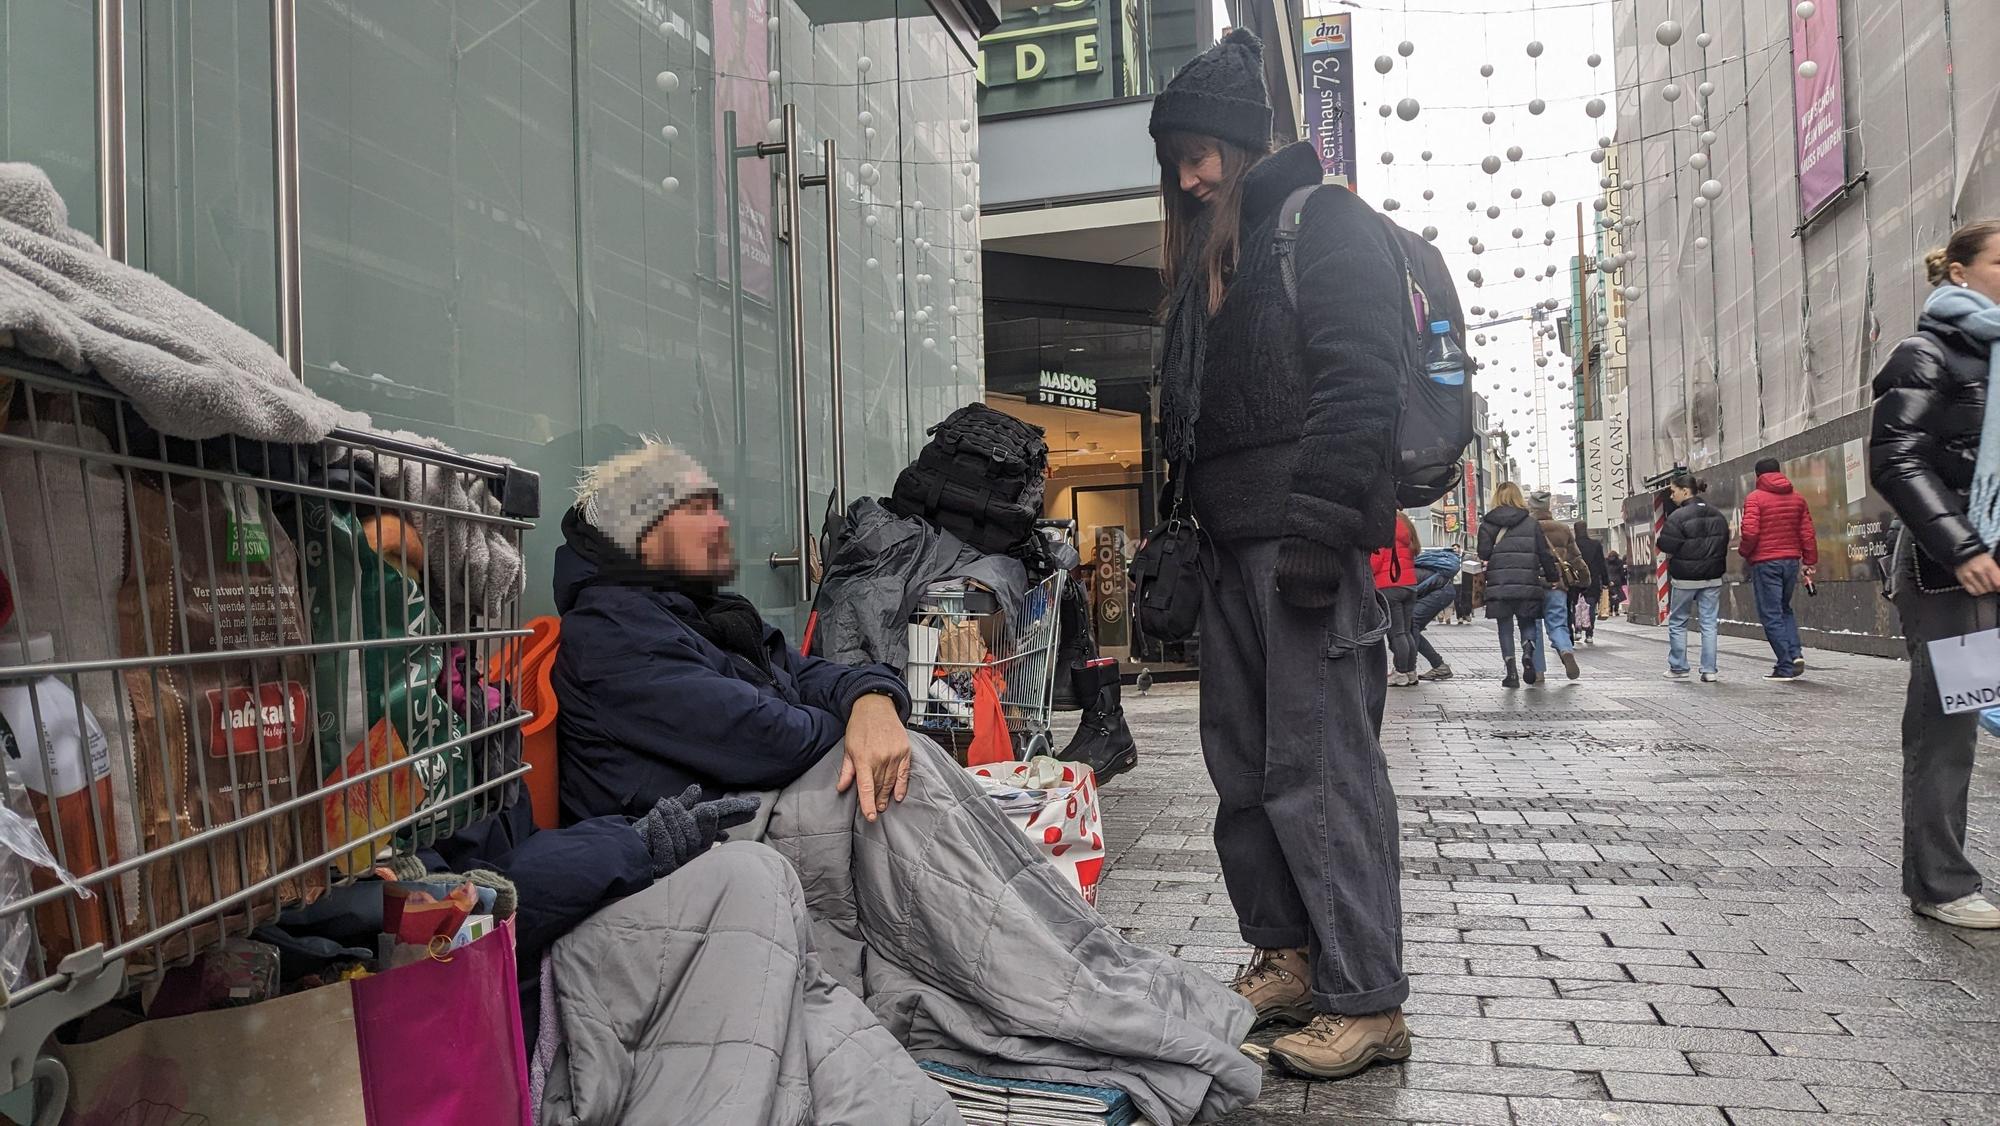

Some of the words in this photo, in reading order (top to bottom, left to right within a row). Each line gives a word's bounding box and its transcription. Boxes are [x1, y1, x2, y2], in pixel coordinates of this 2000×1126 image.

[1316, 22, 1340, 38] dm
[1312, 56, 1341, 89] 73
[1318, 89, 1336, 177] Eventhaus
[1816, 126, 1842, 161] PUMPEN
[1040, 370, 1097, 396] MAISONS
[1040, 392, 1054, 403] DU
[1060, 396, 1097, 410] MONDE
[1609, 412, 1625, 501] LASCANA
[1589, 436, 1603, 514] LASCANA
[1629, 522, 1651, 566] VANS
[1846, 521, 1866, 538] Coming
[1100, 532, 1113, 595] GOOD
[1848, 543, 1869, 559] Cologne
[1944, 685, 2000, 711] PAND
